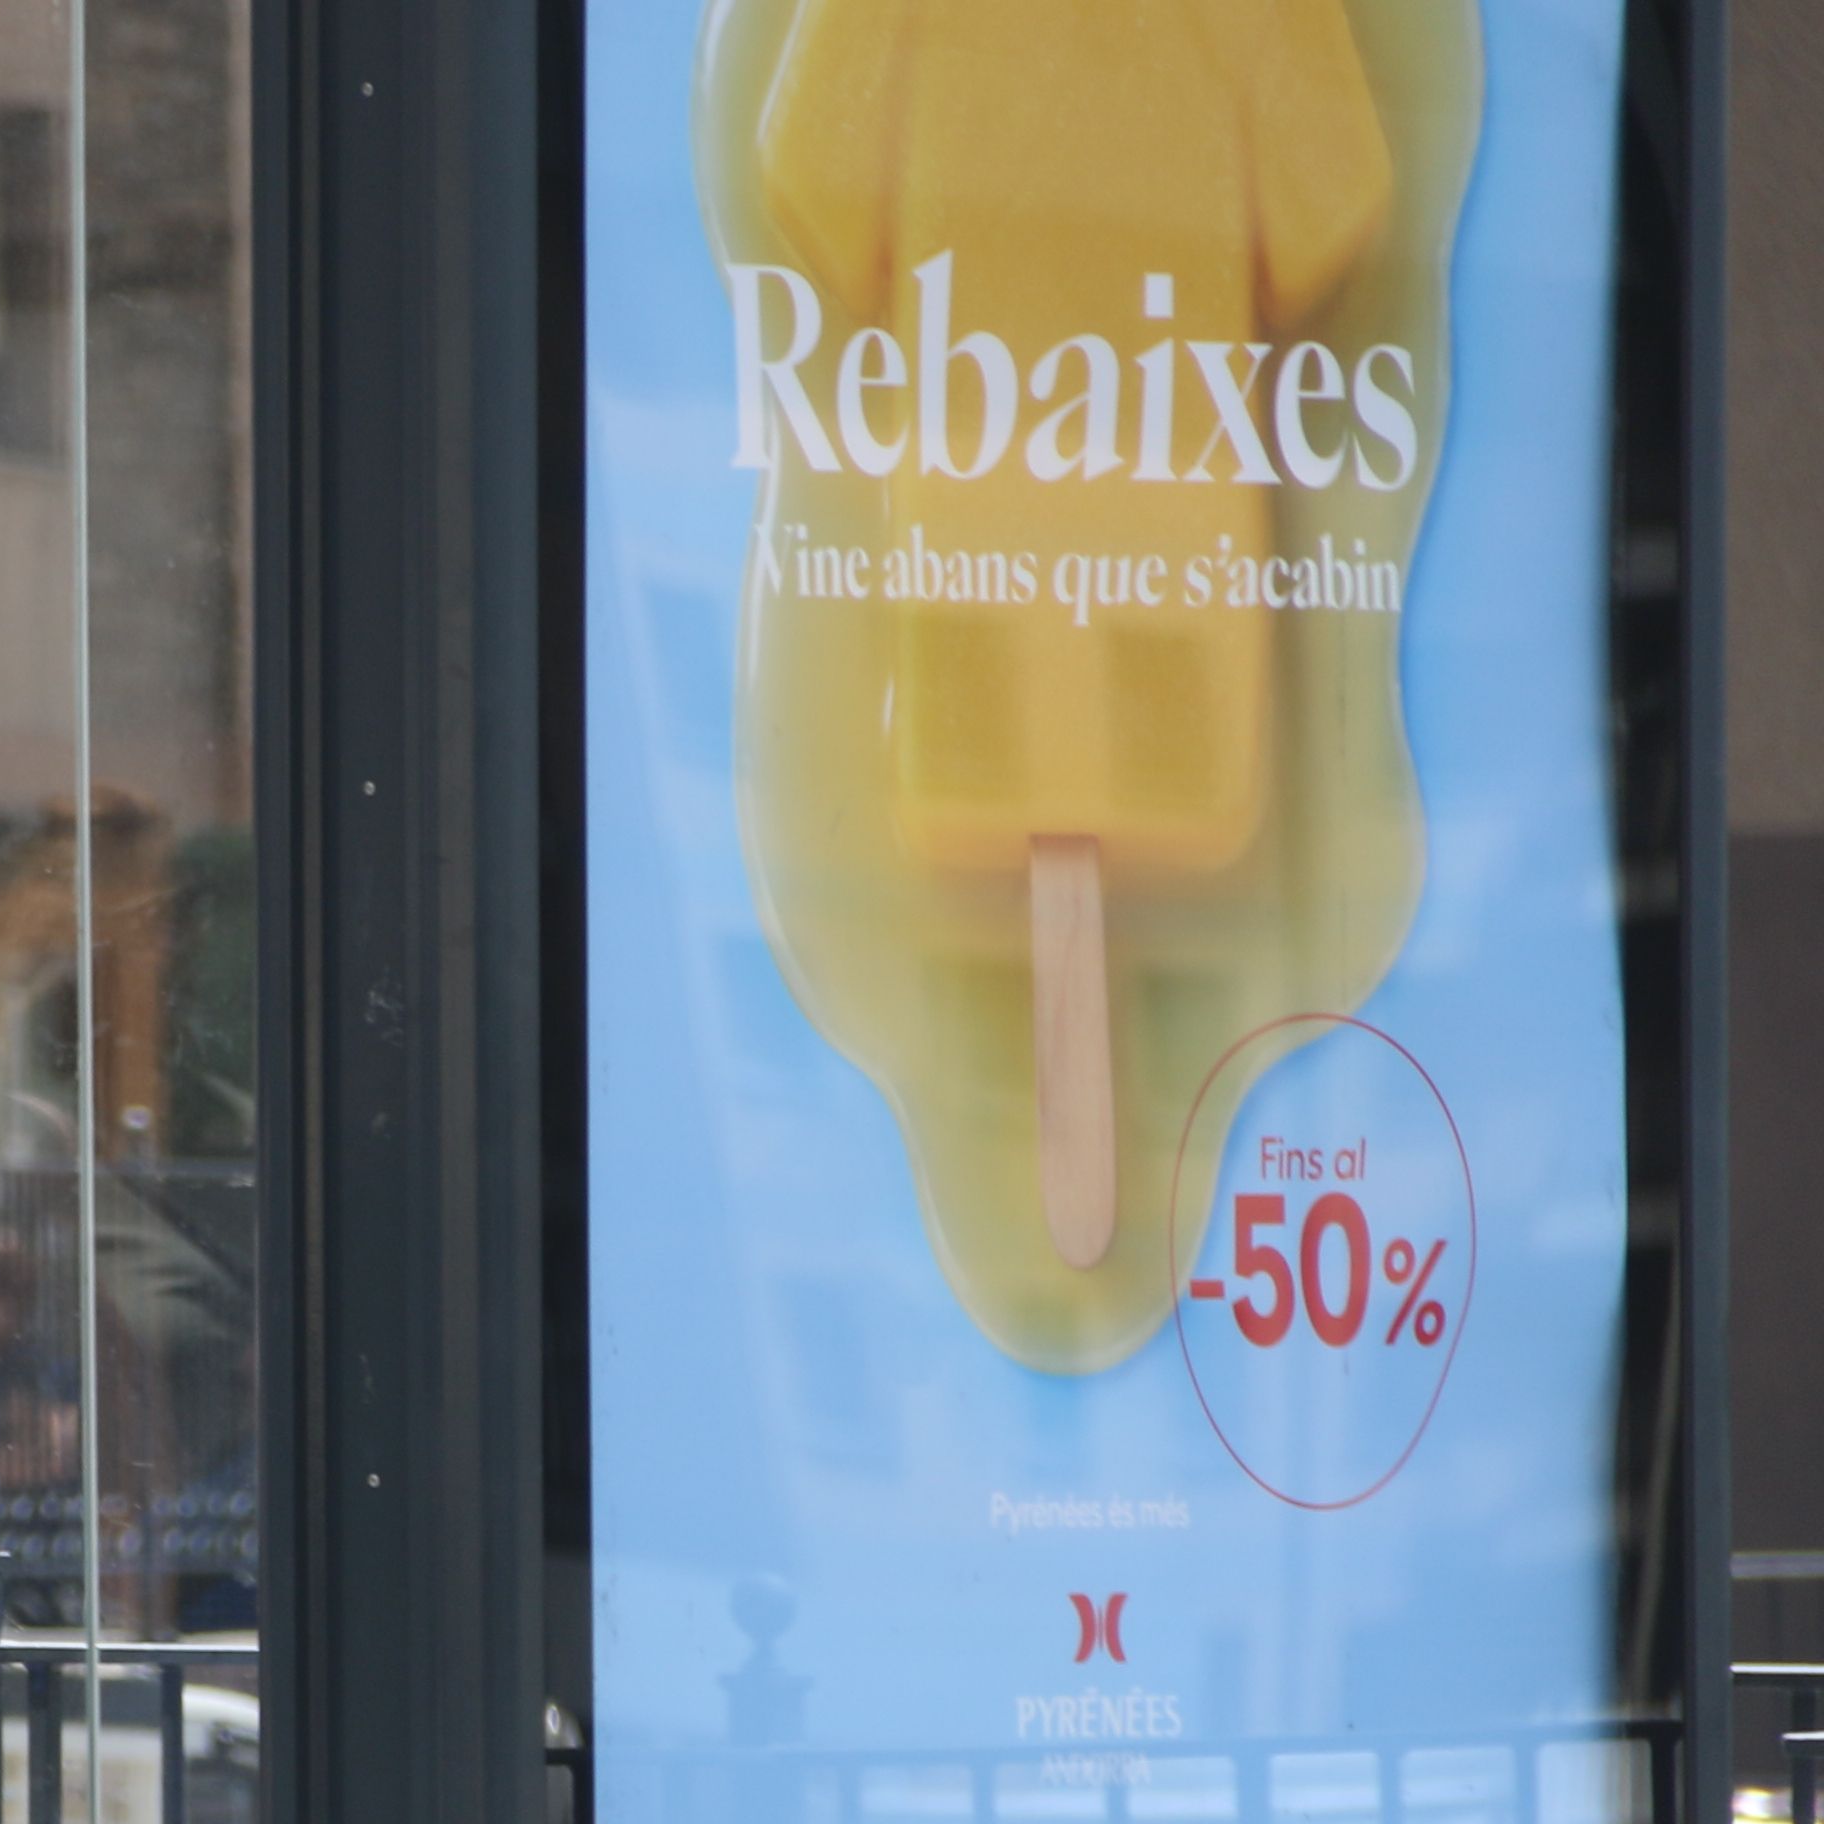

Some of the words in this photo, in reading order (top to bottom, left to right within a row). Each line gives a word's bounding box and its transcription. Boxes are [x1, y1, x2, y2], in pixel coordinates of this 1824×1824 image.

[725, 249, 1419, 492] Rebaixes
[752, 519, 870, 600] Vine
[882, 524, 1039, 603] abans
[1052, 552, 1169, 626] que
[1183, 532, 1402, 613] s'acabin
[1259, 1136, 1324, 1181] Fins
[1333, 1137, 1367, 1181] al
[1188, 1191, 1449, 1349] -50%
